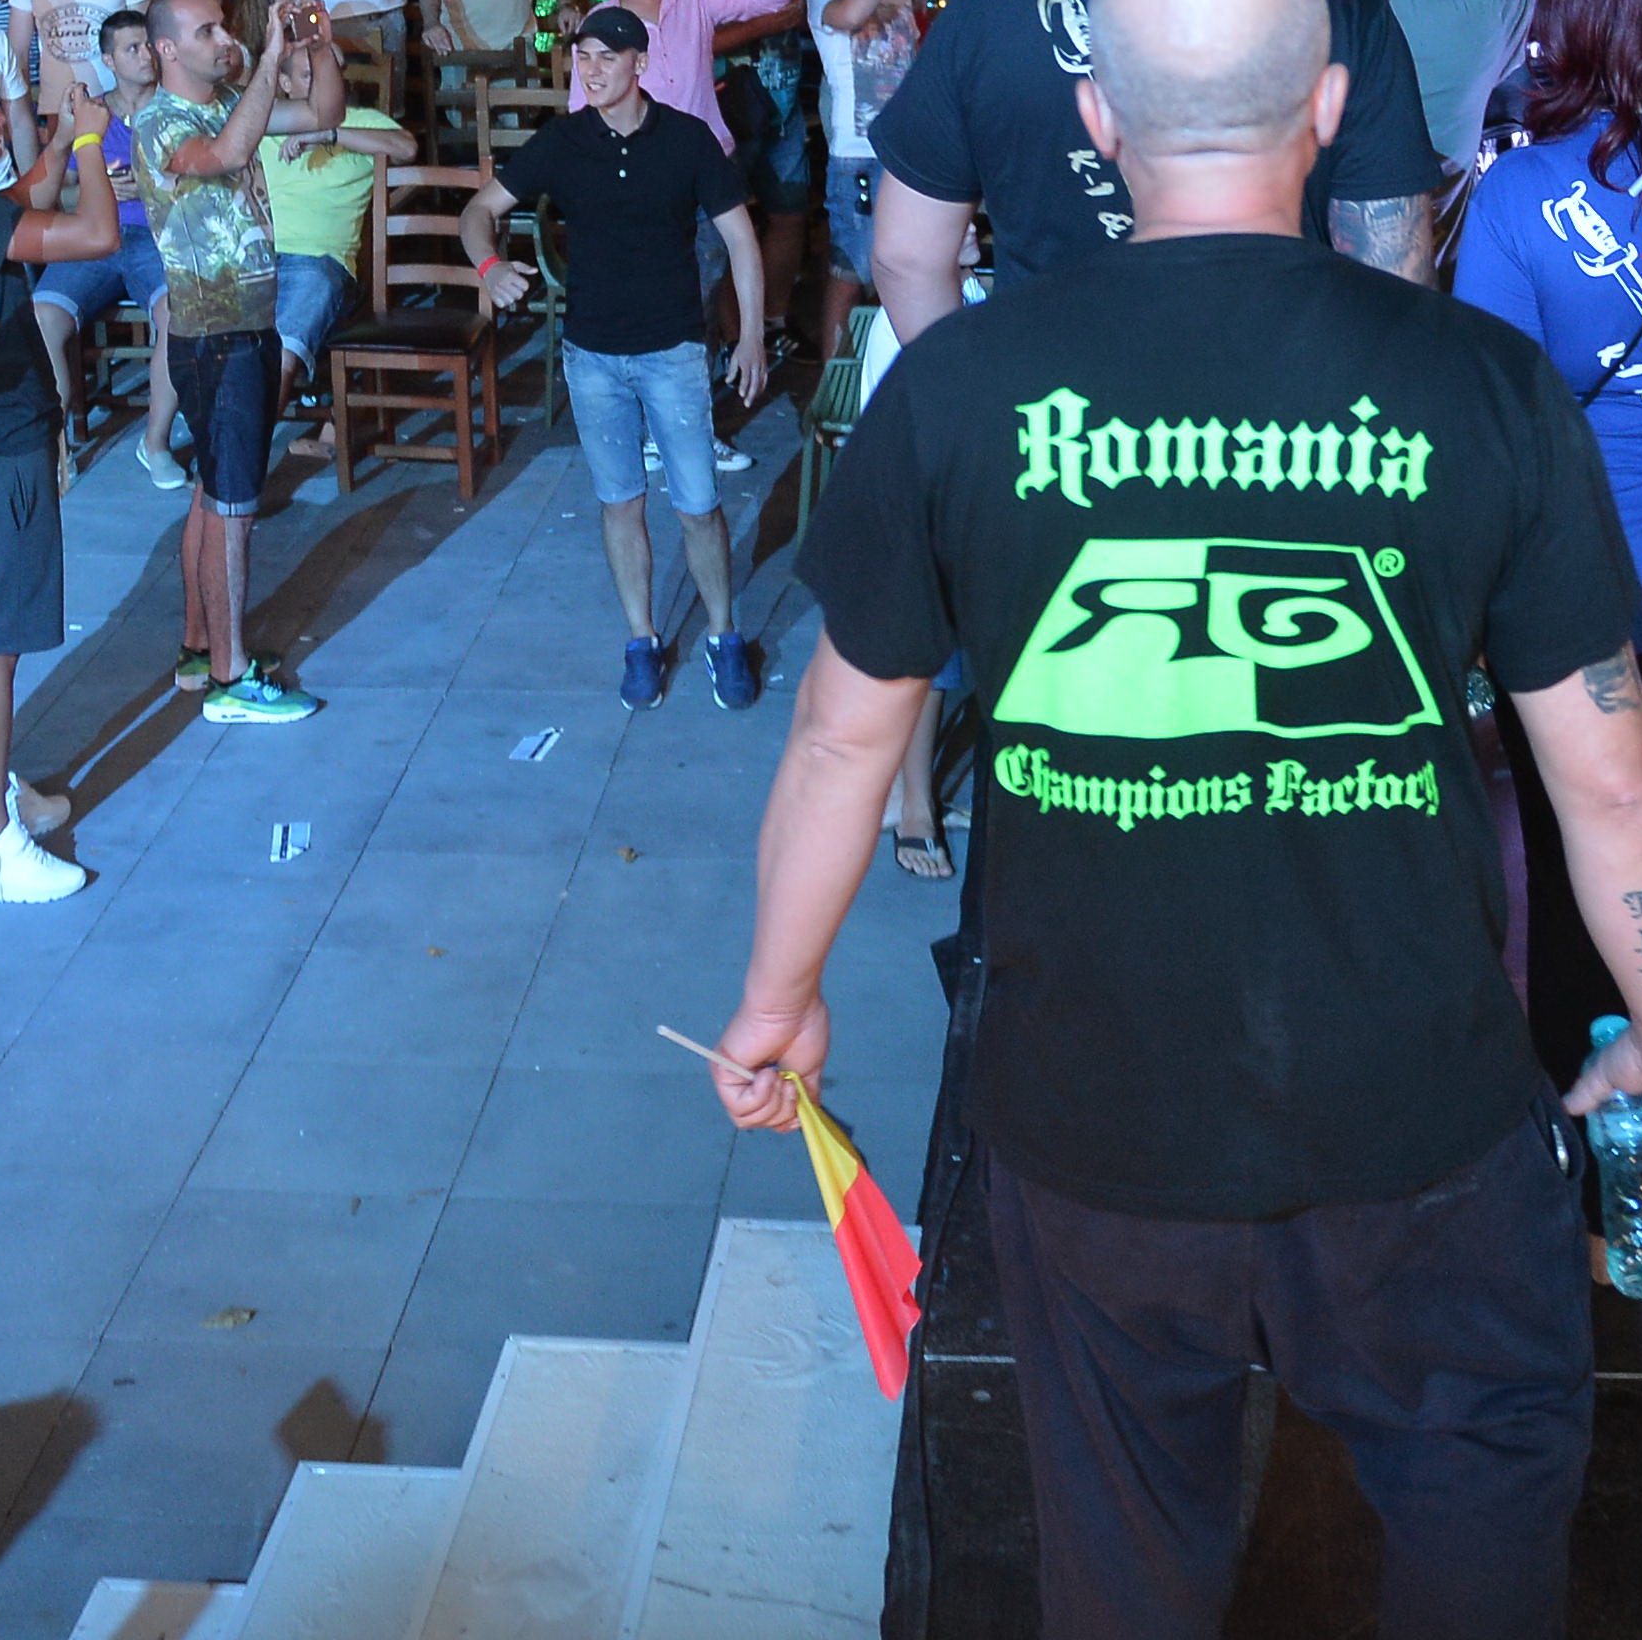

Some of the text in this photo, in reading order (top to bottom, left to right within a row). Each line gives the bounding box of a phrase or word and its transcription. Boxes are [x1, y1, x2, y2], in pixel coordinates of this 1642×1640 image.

[1015, 387, 1434, 508] Romania
[993, 743, 1440, 832] Champions Factory
